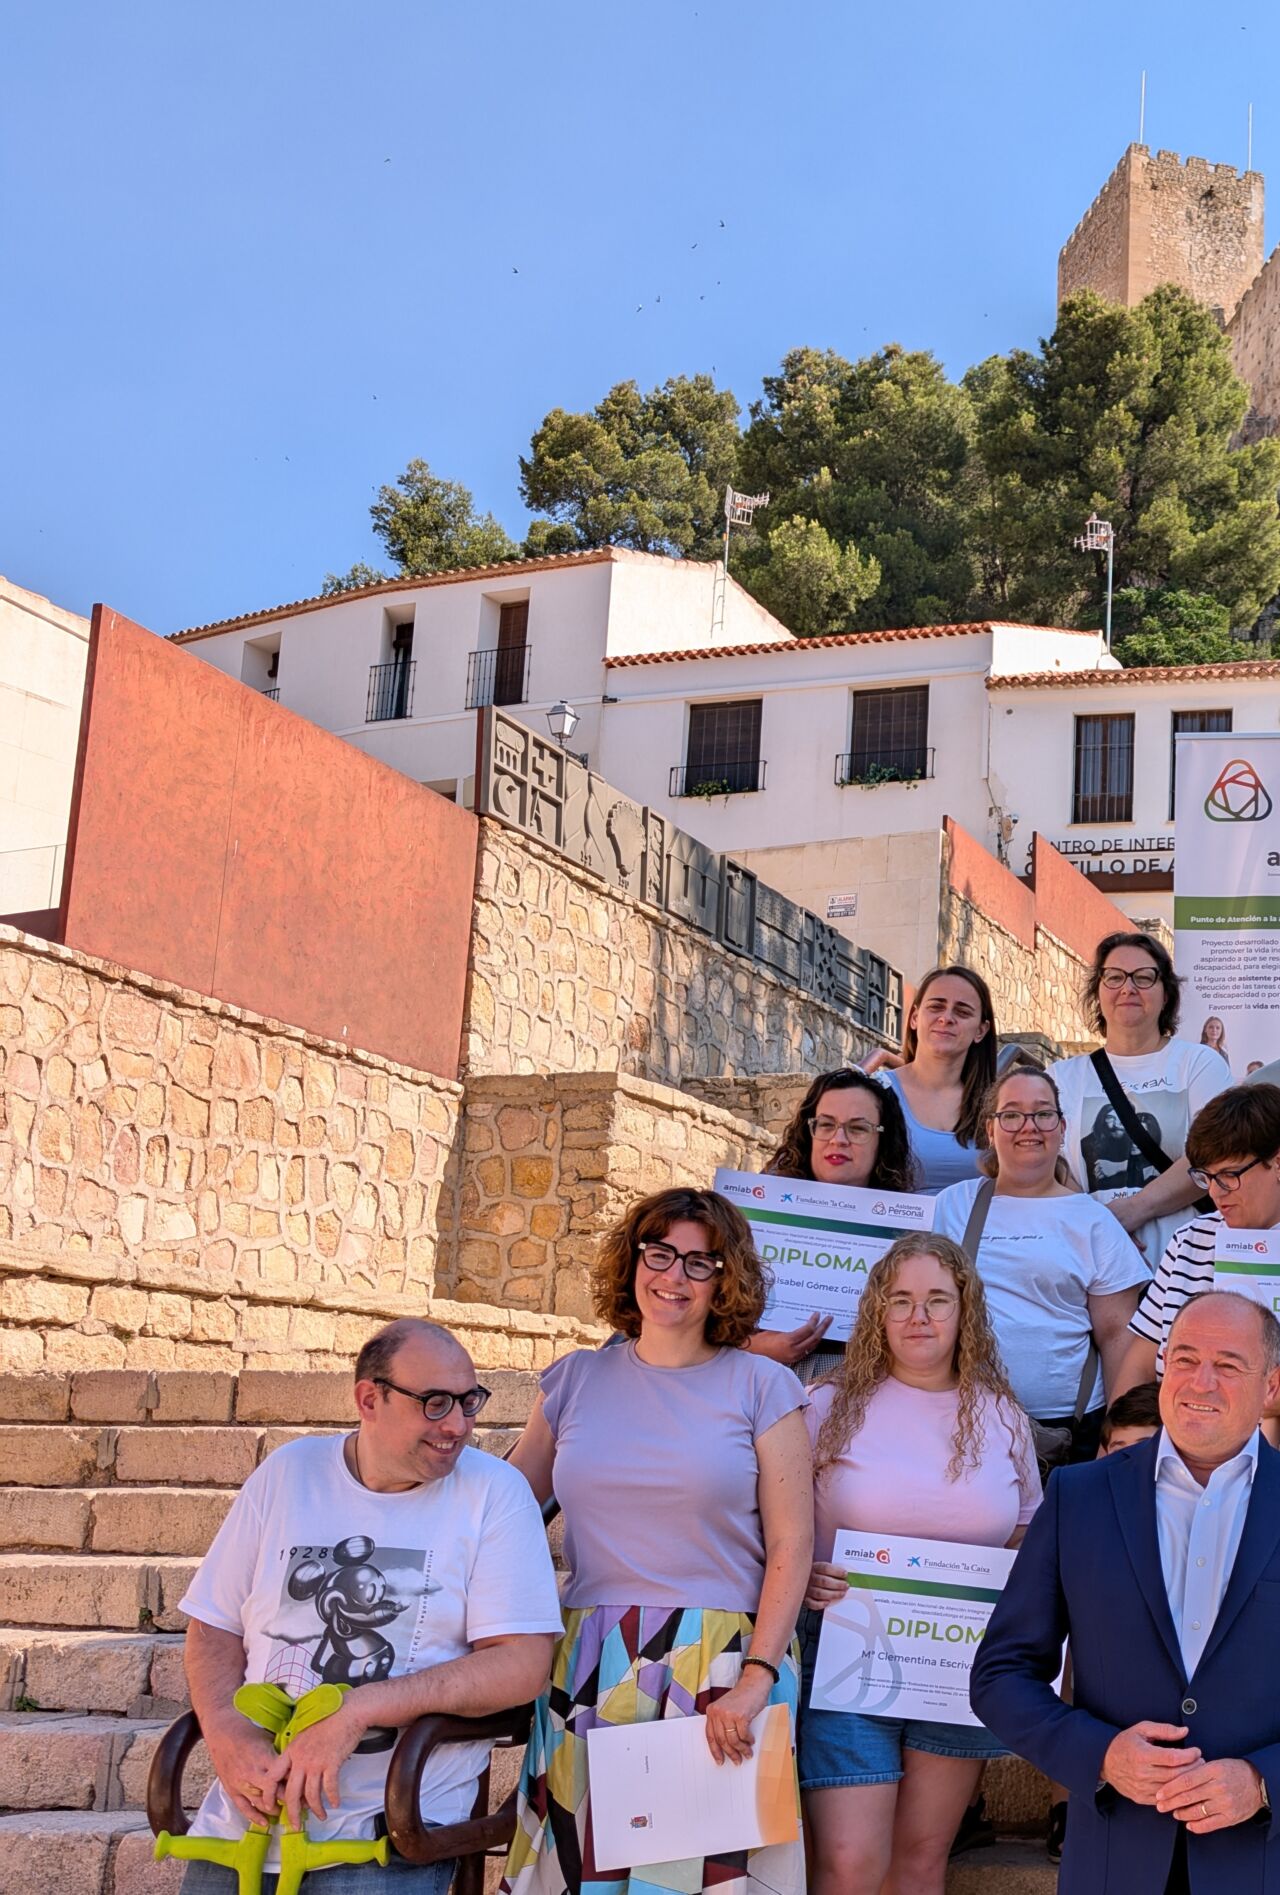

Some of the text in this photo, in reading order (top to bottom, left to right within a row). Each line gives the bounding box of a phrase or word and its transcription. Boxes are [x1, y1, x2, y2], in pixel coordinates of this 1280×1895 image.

[1102, 839, 1123, 851] DE
[1129, 837, 1175, 851] INTER
[1134, 858, 1162, 873] DE
[1227, 915, 1261, 923] Atención
[1201, 939, 1233, 947] Proyecto
[1200, 955, 1236, 963] aspirando
[1261, 963, 1280, 971] elegir
[1213, 991, 1260, 999] discapacidad
[723, 1184, 751, 1194] amiab
[888, 1206, 924, 1218] Personal
[1226, 1242, 1253, 1250] amiab
[762, 1244, 868, 1274] DIPLOMA
[776, 1277, 804, 1288] Isabel
[806, 1281, 839, 1292] Gómez
[279, 1547, 328, 1560] 1928
[845, 1548, 875, 1559] amiab
[924, 1558, 960, 1570] Fundación
[971, 1564, 990, 1573] Caixa
[887, 1617, 985, 1645] DIPLOM
[877, 1651, 937, 1666] Clementina
